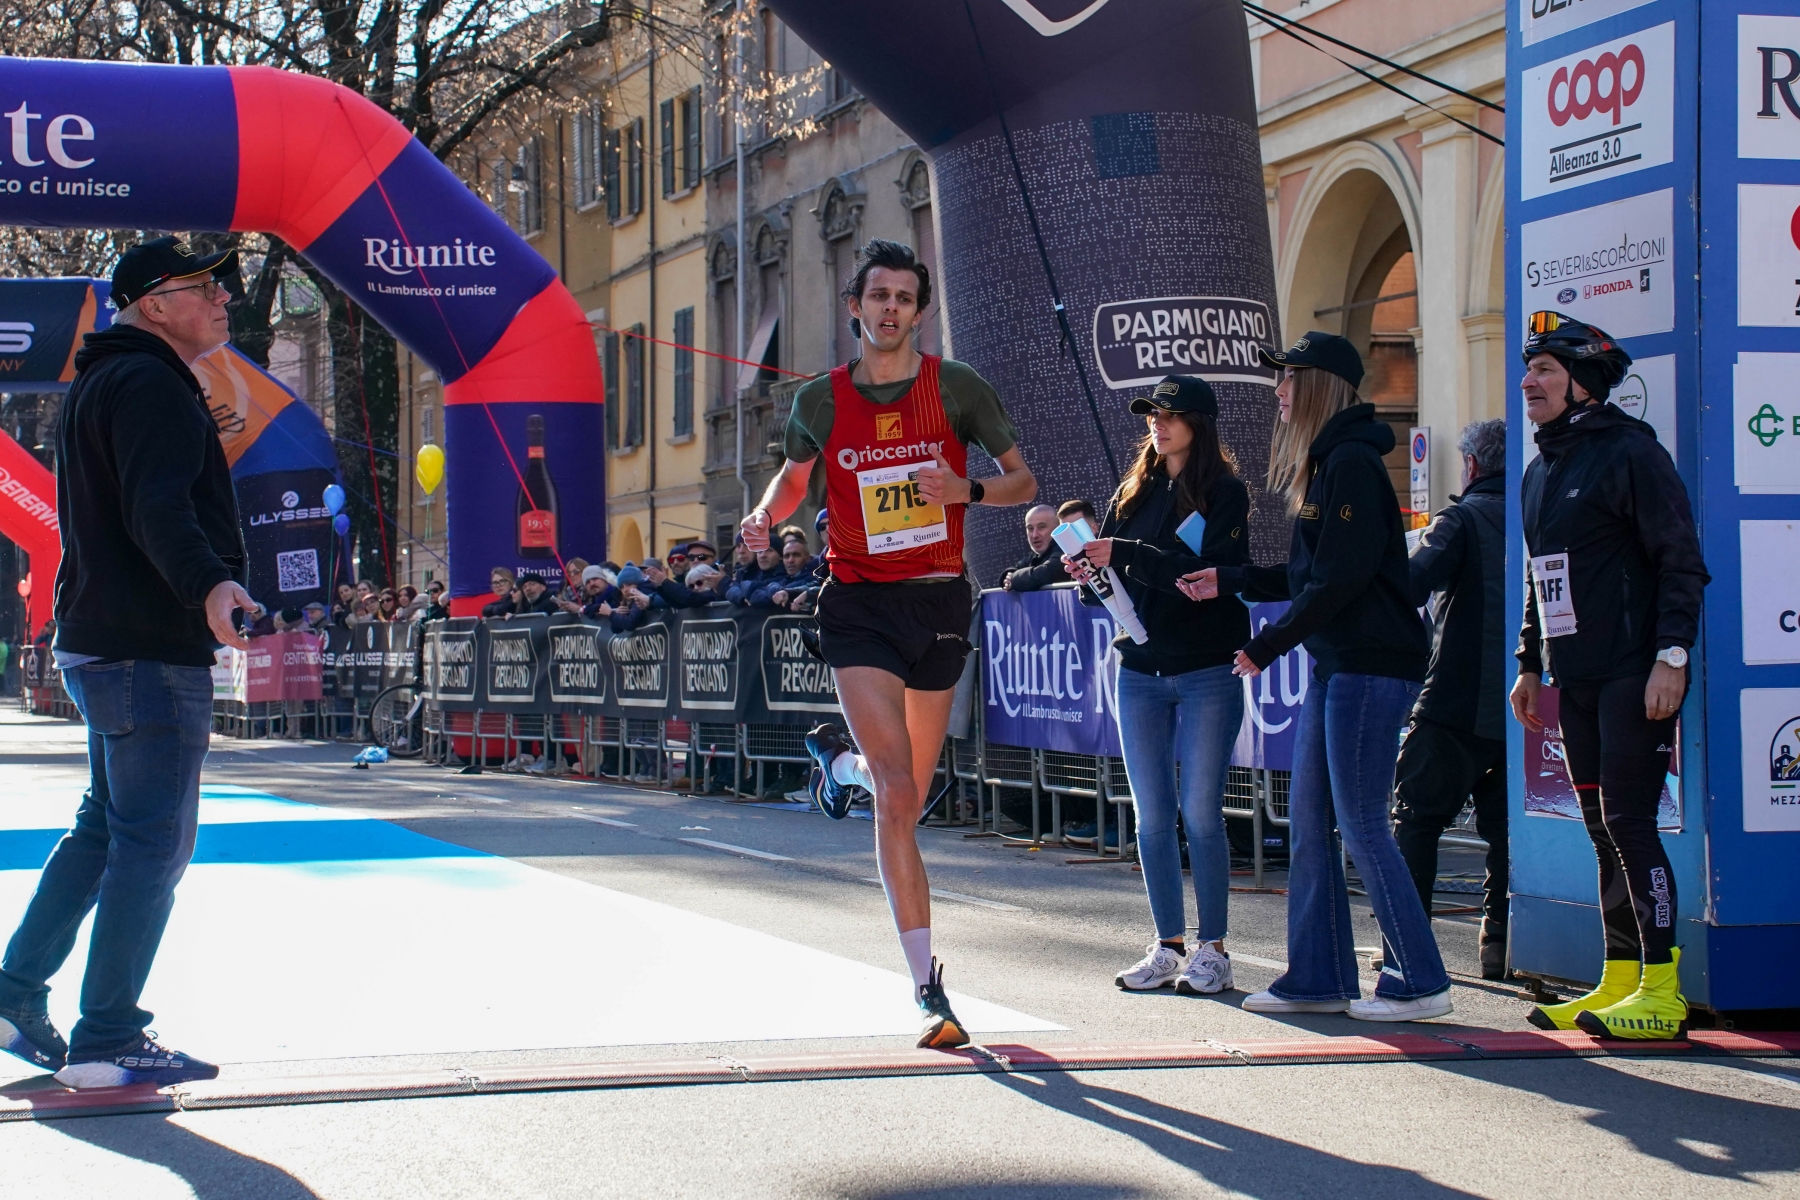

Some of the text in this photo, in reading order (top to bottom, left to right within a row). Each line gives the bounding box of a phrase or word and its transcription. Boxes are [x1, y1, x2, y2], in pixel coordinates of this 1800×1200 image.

[1548, 44, 1645, 127] coop
[1549, 137, 1621, 175] Alleanza 3.0
[29, 176, 49, 194] ci
[56, 178, 131, 197] unisce
[363, 237, 497, 275] Riunite
[1543, 237, 1665, 280] SEVERI&SCORCIONI
[378, 283, 442, 297] Lambrusco
[444, 285, 456, 296] ci
[458, 284, 497, 296] unisce
[1593, 279, 1634, 296] HONDA
[1112, 308, 1267, 341] PARMIGIANO
[1135, 338, 1261, 370] REGGIANO
[838, 440, 945, 470] Oriocentr
[876, 483, 928, 513] 2715
[913, 531, 940, 543] Riunite
[1536, 577, 1563, 603] TAFF
[1780, 610, 1800, 633] C
[612, 634, 666, 661] PARMIGIANO
[683, 630, 734, 660] PARMIGIANO
[622, 664, 661, 690] REGGIANO
[686, 663, 728, 692] REGGIANO
[1657, 904, 1669, 926] BIKE
[100, 1056, 183, 1068] YSSES
